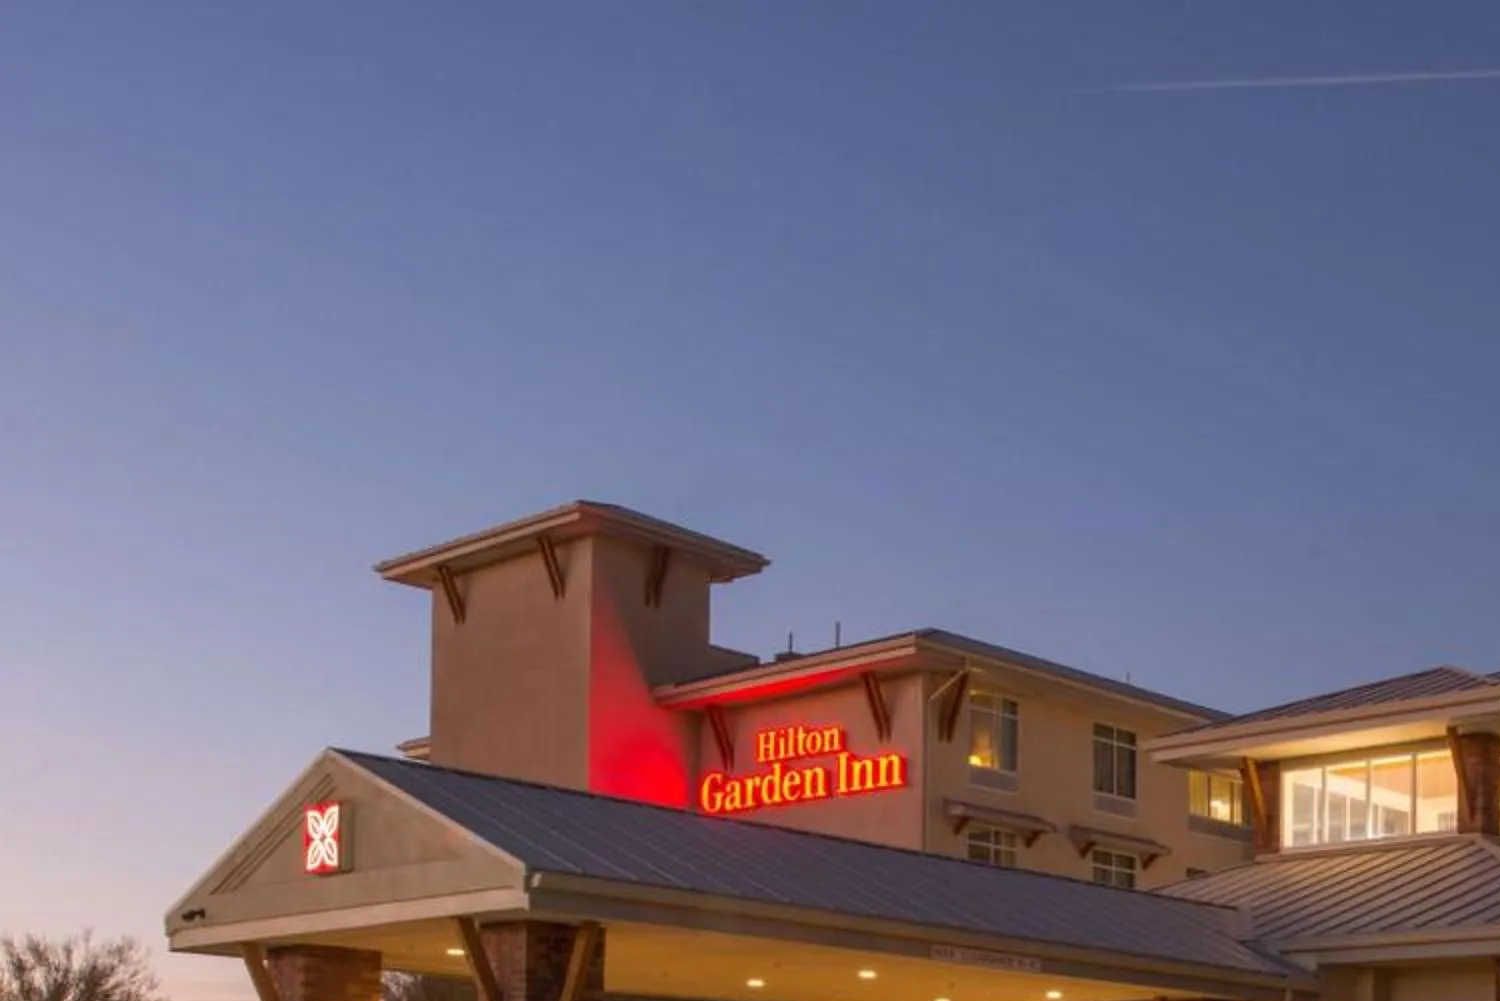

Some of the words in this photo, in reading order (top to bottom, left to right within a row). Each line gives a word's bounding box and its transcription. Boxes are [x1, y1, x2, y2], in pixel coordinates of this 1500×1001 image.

[756, 724, 843, 763] Hilton
[700, 762, 828, 814] Garden
[835, 750, 904, 794] Inn
